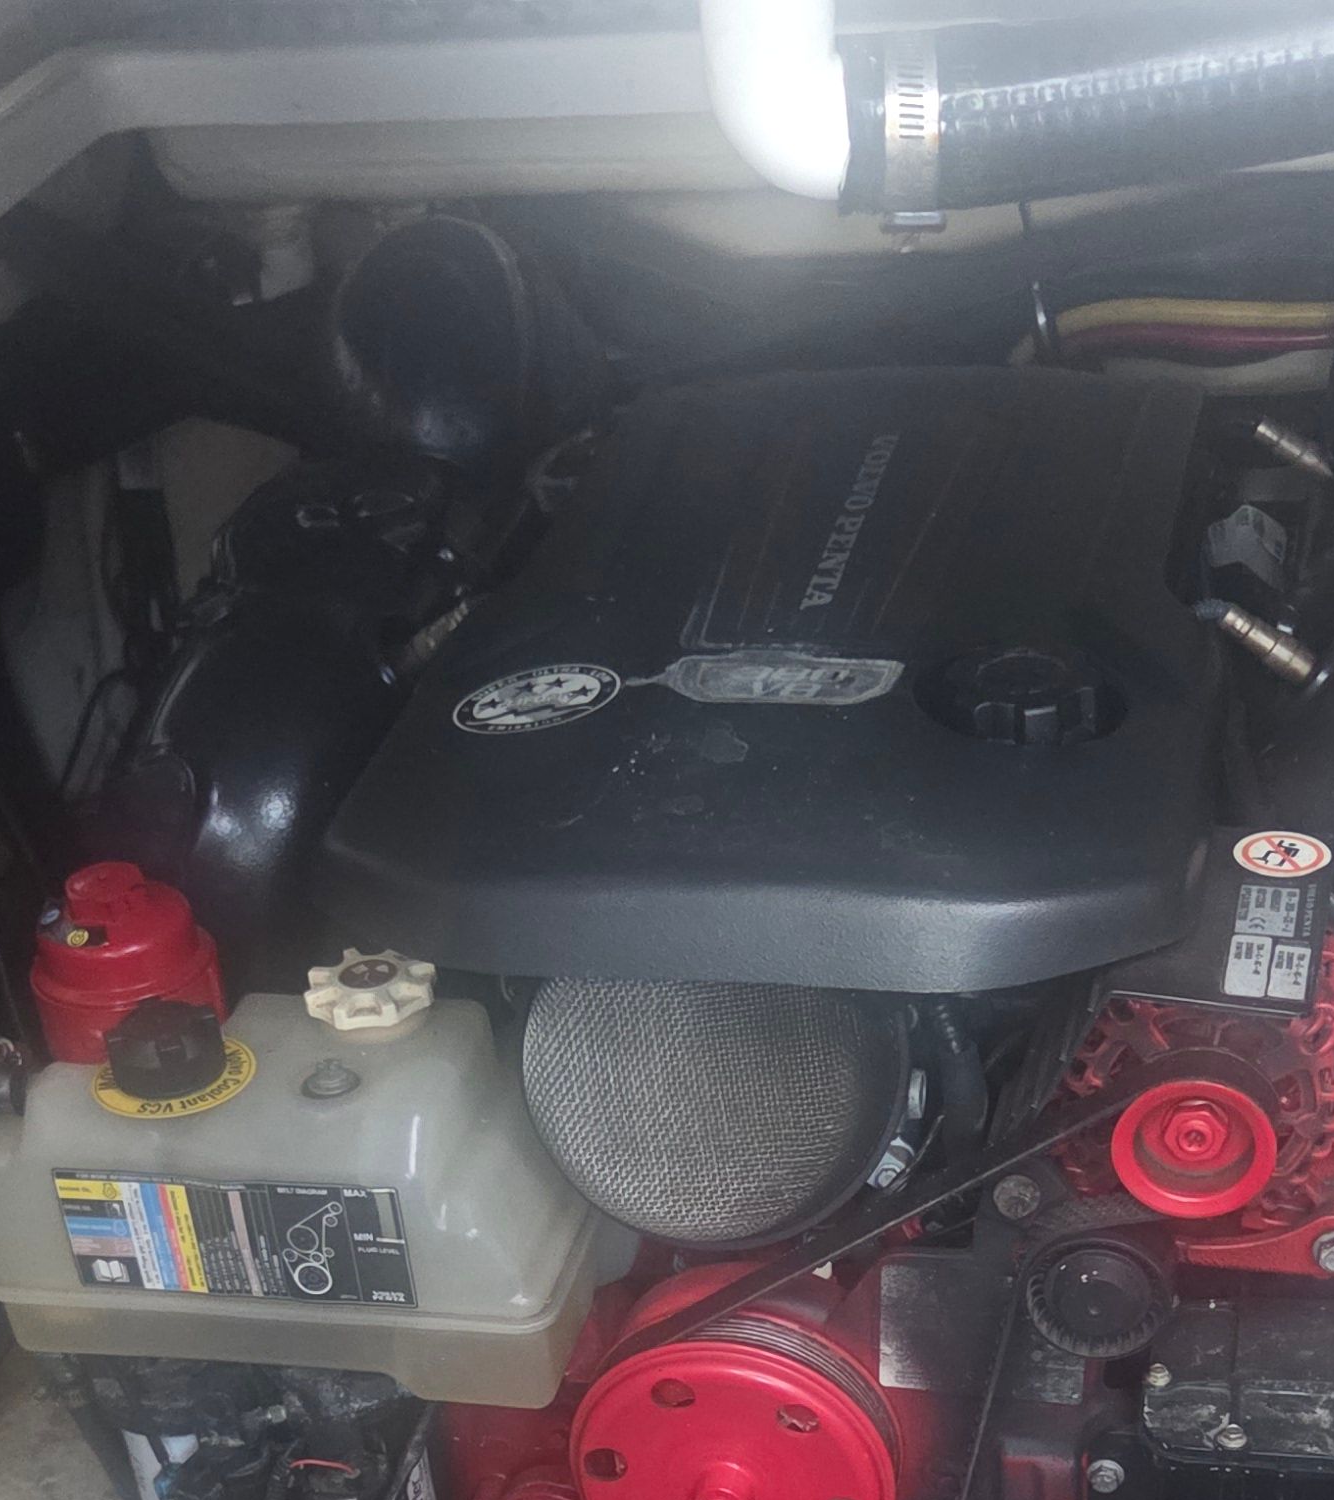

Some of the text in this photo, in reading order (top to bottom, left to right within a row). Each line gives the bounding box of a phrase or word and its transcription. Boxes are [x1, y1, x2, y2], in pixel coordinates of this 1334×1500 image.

[799, 434, 900, 611] VOLVO PENTA
[180, 1077, 241, 1107] Coolant
[137, 1101, 174, 1115] VCS
[343, 1188, 368, 1198] MAX
[353, 1232, 374, 1242] MIN
